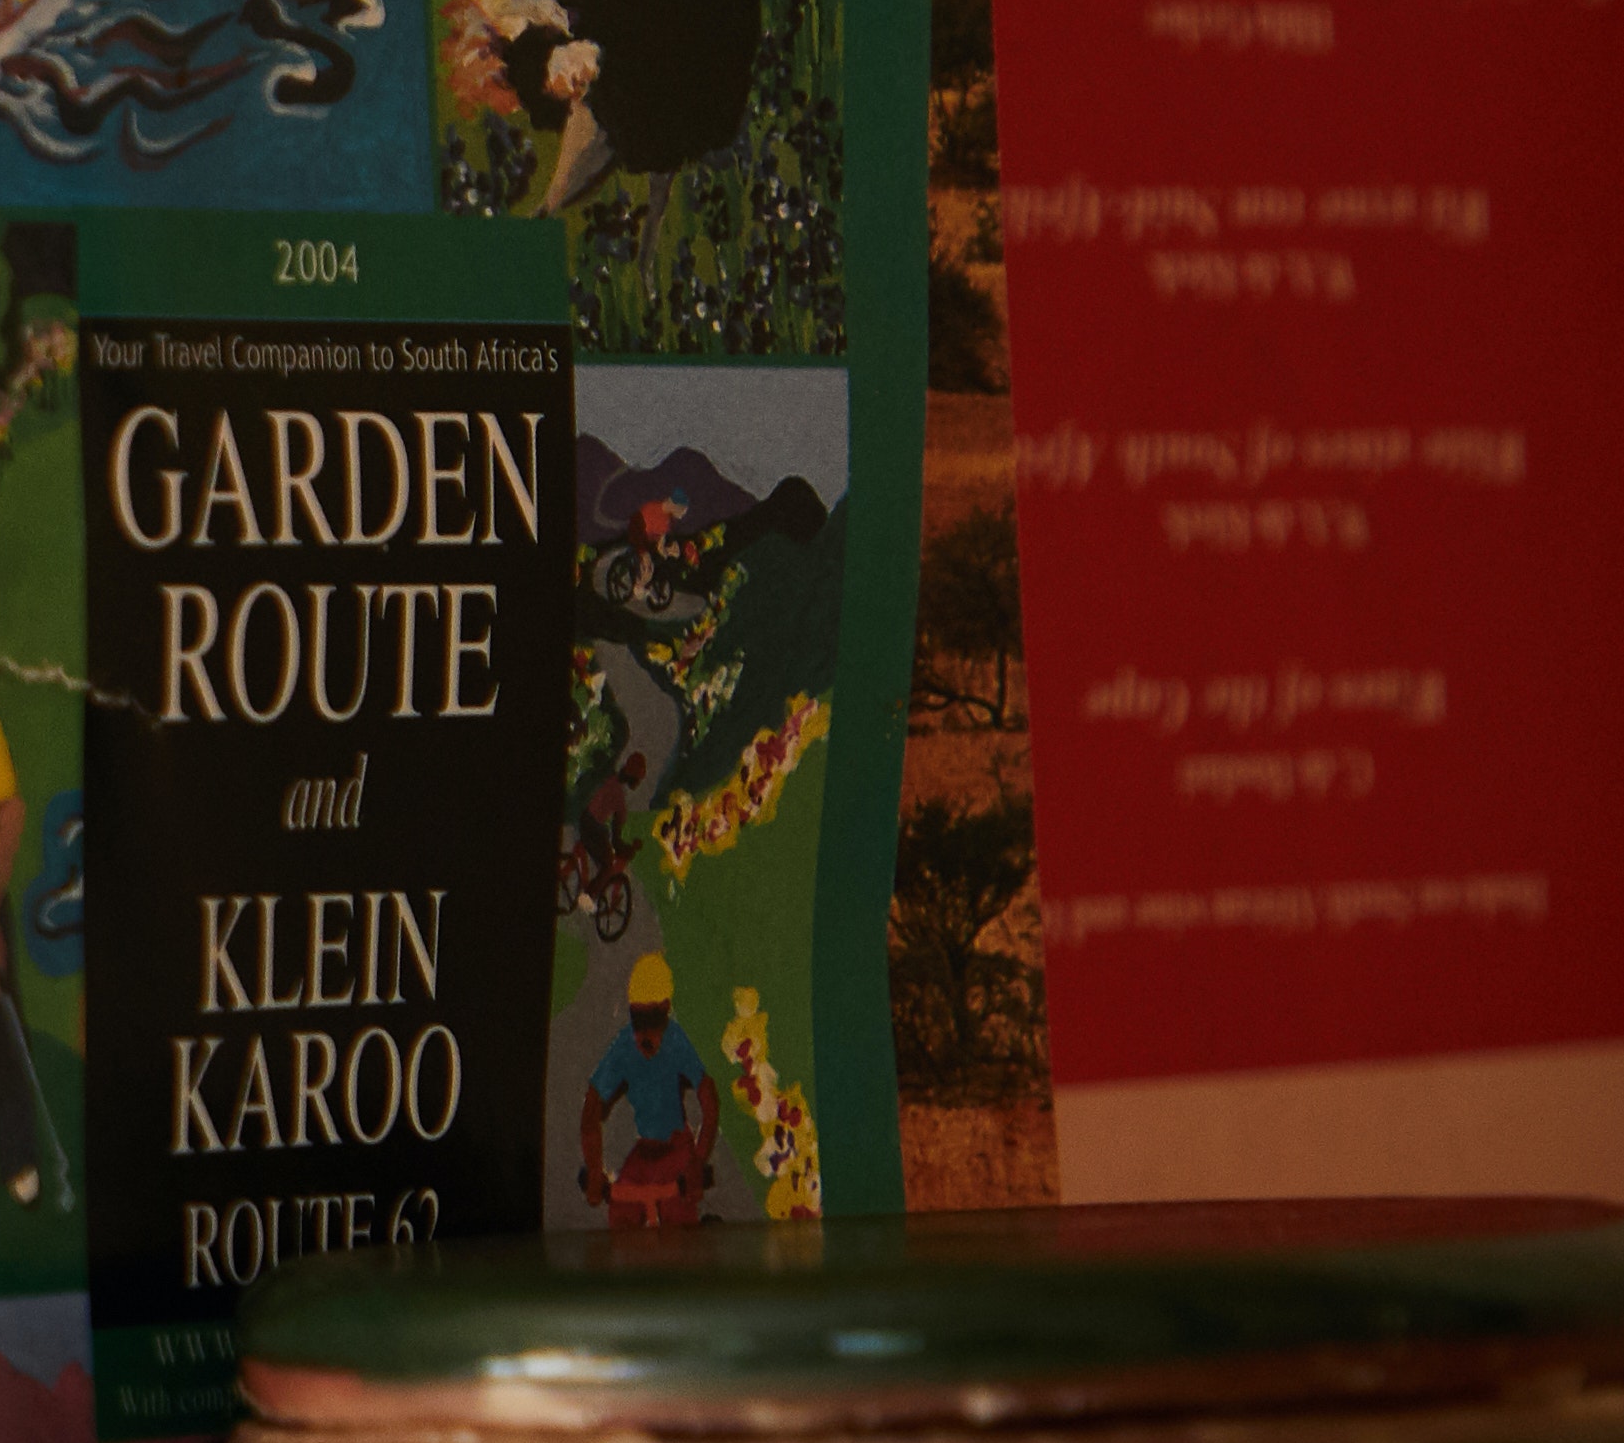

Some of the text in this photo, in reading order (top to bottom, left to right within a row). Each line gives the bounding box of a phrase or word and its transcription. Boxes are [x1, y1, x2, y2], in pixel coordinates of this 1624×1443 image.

[275, 240, 360, 284] 2004
[91, 333, 559, 377] Your Travel Companion to South Africa's
[109, 406, 544, 549] GARDEN
[159, 582, 499, 723] ROUTE
[283, 752, 367, 830] and
[198, 889, 448, 1014] KLEIN
[170, 1024, 462, 1154] KAROO
[183, 1193, 376, 1288] ROUTE
